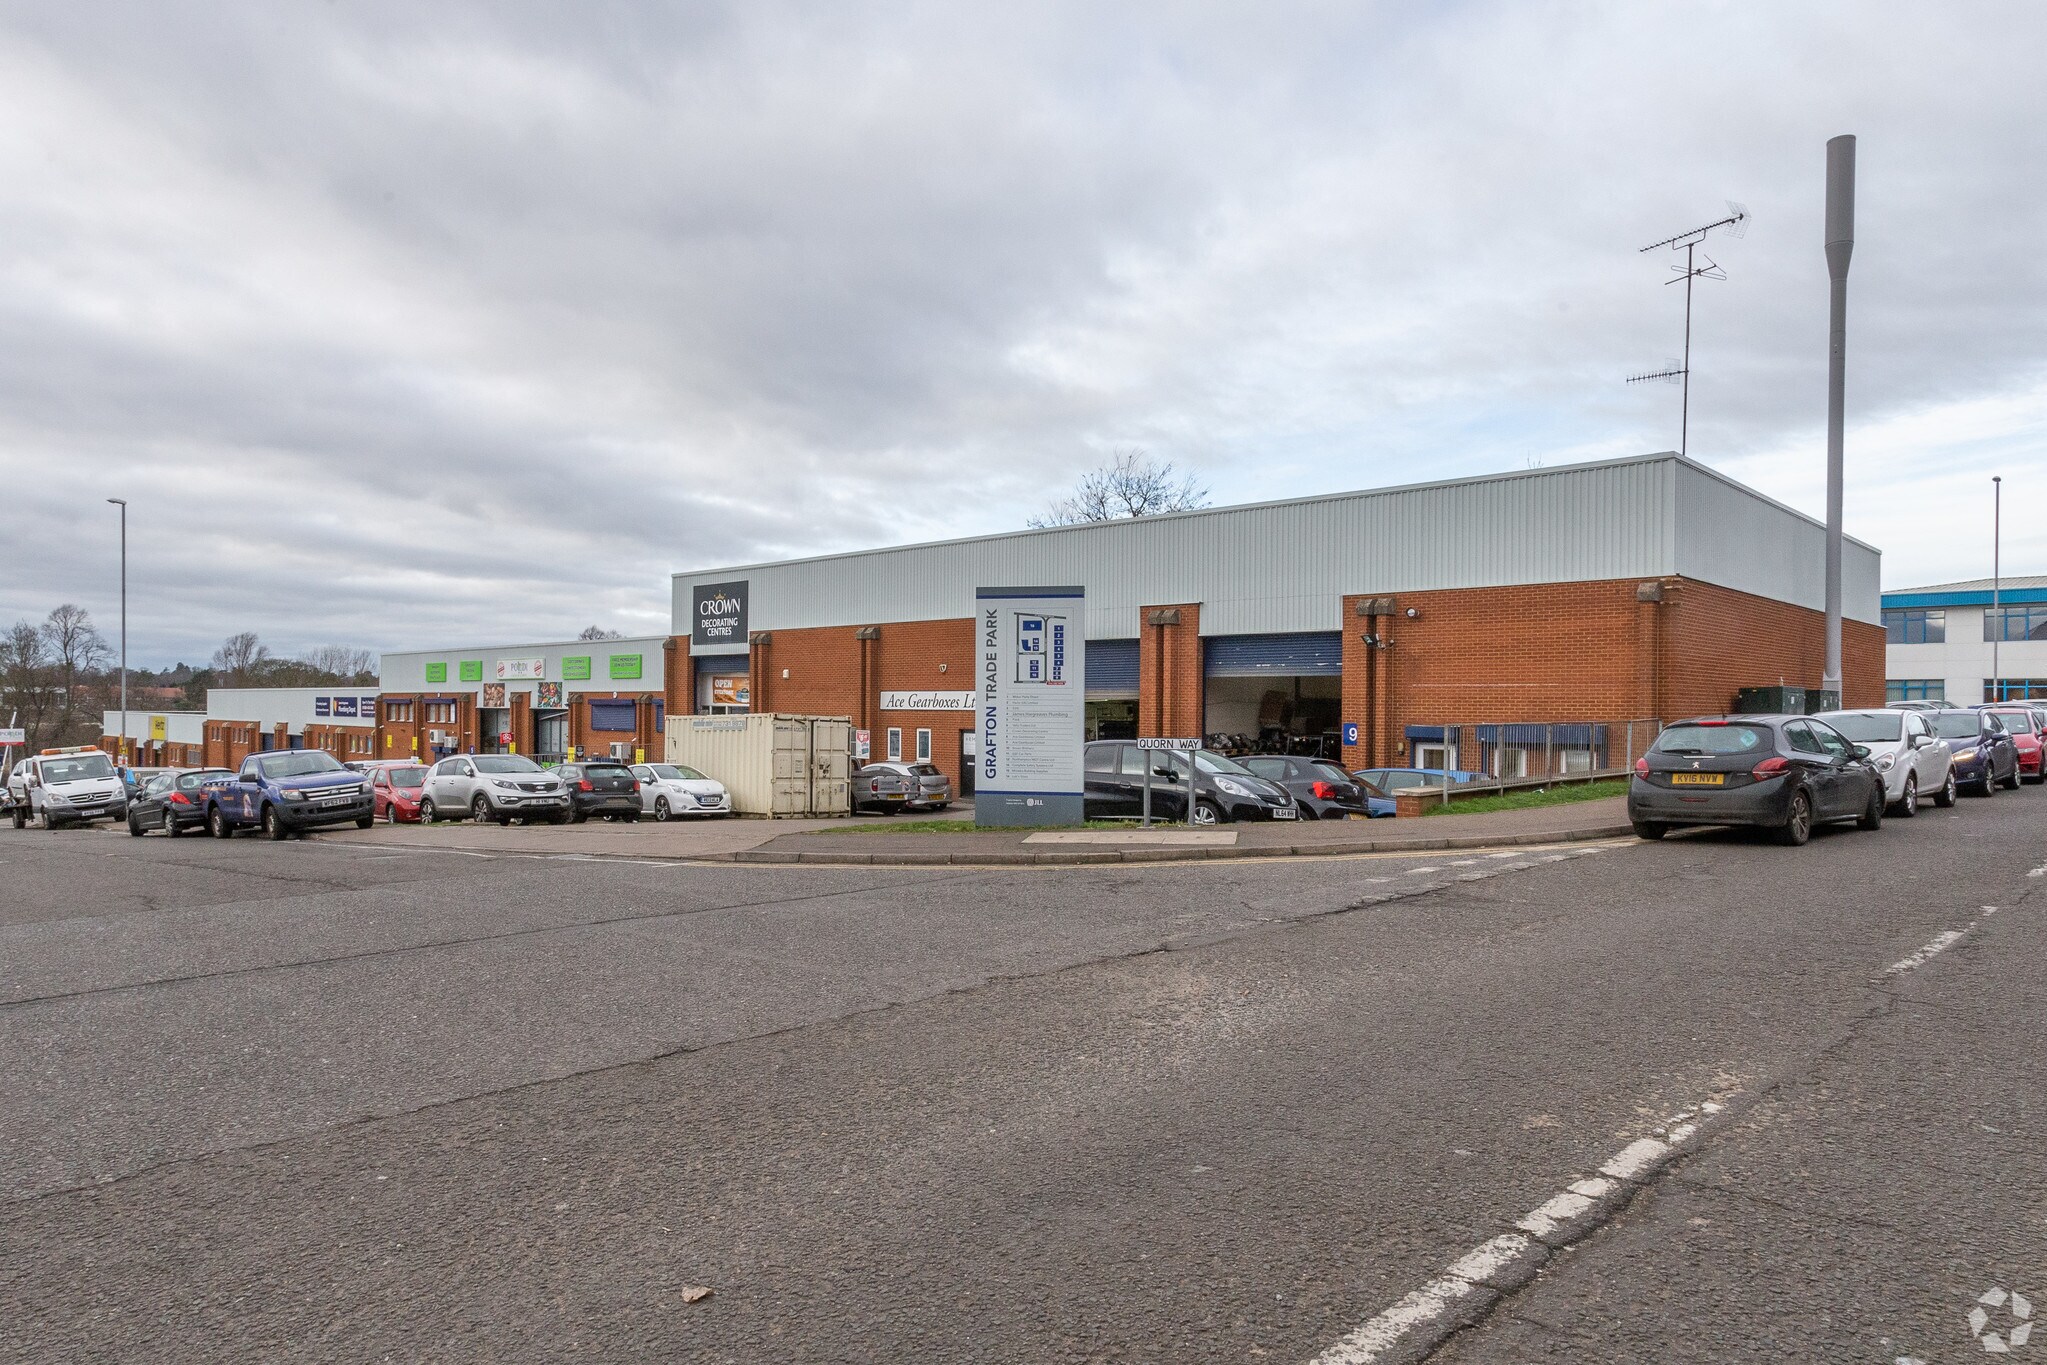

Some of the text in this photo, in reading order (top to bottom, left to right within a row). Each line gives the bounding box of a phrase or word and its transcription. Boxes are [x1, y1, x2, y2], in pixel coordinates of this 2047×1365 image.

[700, 598, 741, 615] CROWN
[701, 617, 738, 628] DECORATING
[707, 627, 732, 637] CENTRES
[714, 679, 733, 688] OPEN
[985, 609, 997, 779] GRAFTON TRADE PARK
[886, 692, 976, 709] Ace Gearboxes Lt
[1349, 727, 1358, 741] 9
[1139, 739, 1199, 749] QUORN WAY
[1677, 774, 1719, 783] KV16 NVW
